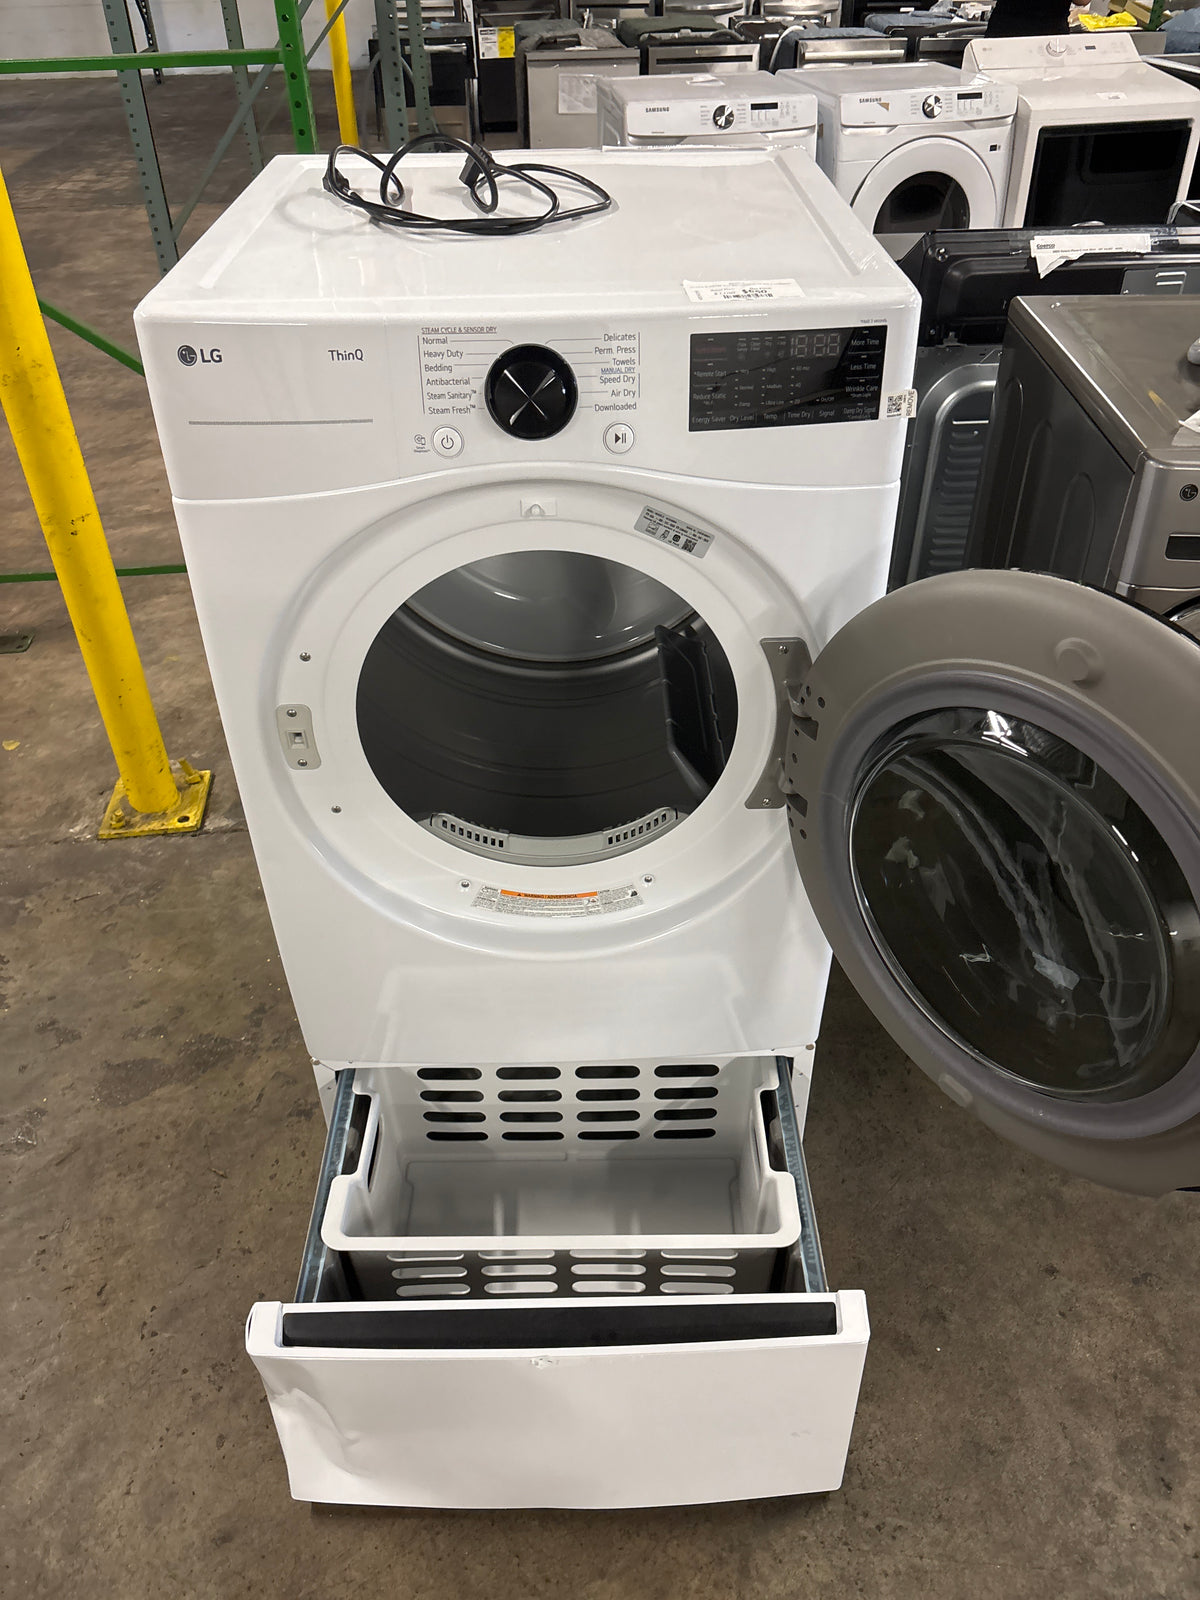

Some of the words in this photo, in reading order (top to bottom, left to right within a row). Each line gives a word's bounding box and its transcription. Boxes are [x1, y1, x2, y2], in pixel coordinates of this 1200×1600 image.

[422, 336, 448, 344] Normal
[604, 333, 636, 342] Delicates
[424, 350, 445, 359] Heavy
[446, 349, 464, 359] Duty
[595, 346, 614, 354] Perm.
[200, 348, 222, 363] LG
[328, 349, 364, 362] ThinQ
[612, 357, 636, 365] Towels
[424, 364, 452, 373] Bedding
[426, 378, 470, 386] Antibacterial
[600, 375, 621, 385] Speed
[623, 375, 636, 384] Dry
[427, 392, 446, 400] Steam
[611, 389, 621, 397] Air
[623, 388, 636, 398] Dry
[594, 402, 637, 412] Downloaded
[906, 391, 915, 416] REMOVE
[729, 415, 739, 423] Dry
